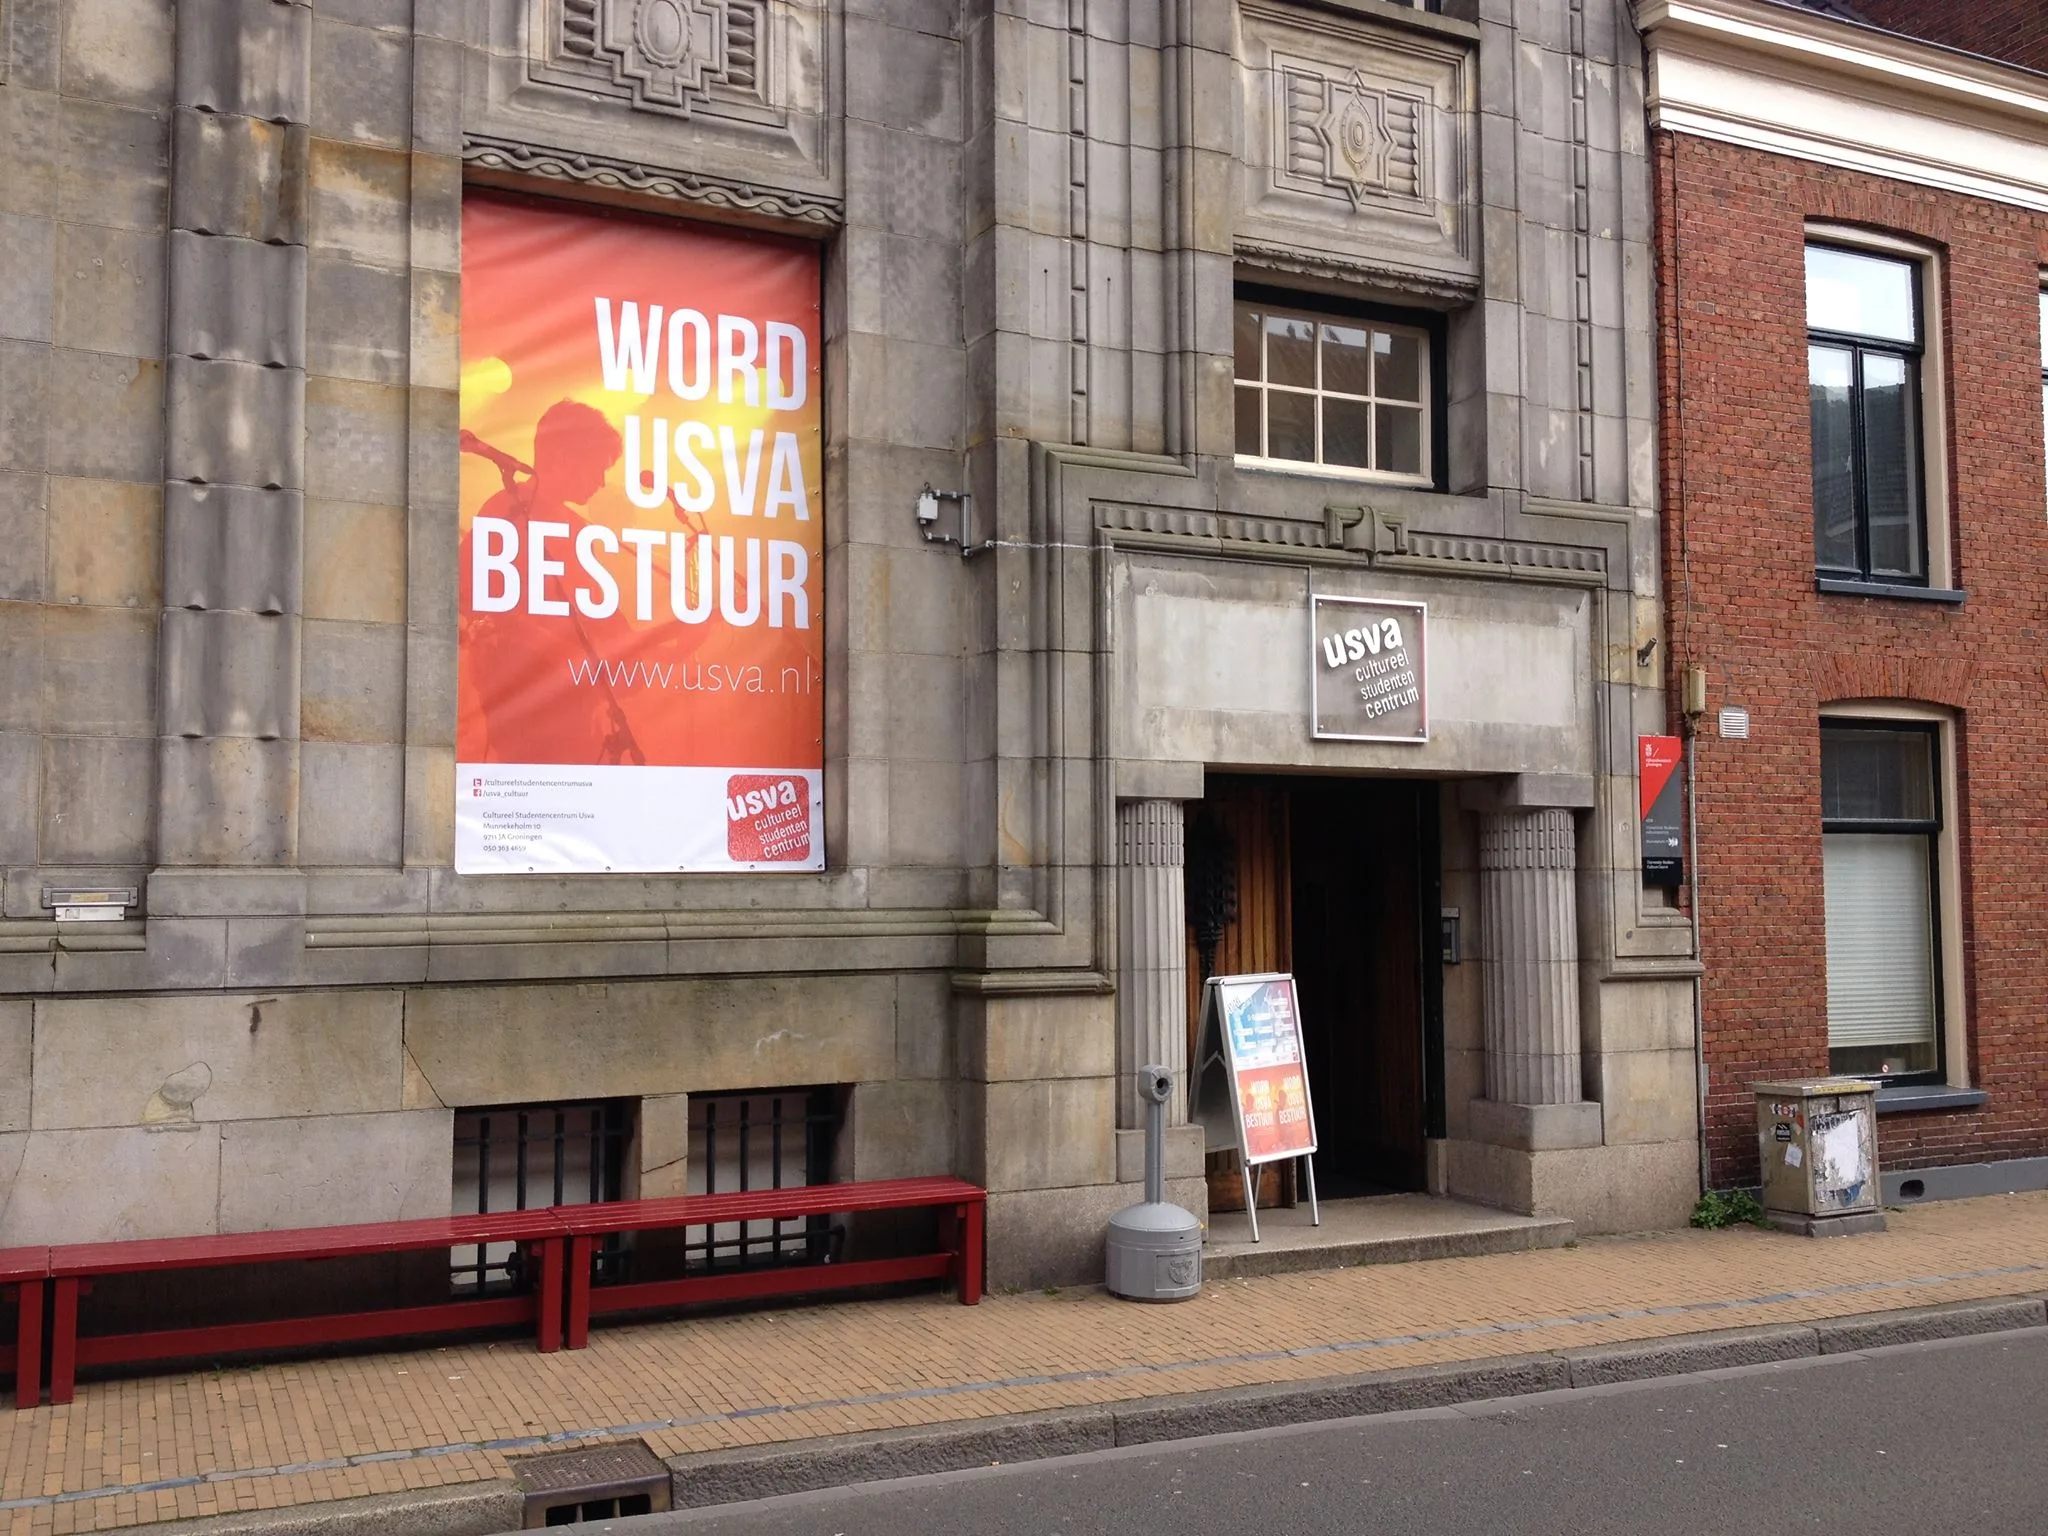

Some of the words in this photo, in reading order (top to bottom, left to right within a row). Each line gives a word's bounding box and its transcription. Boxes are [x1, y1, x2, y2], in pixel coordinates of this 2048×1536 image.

[594, 297, 807, 412] WORD
[624, 415, 810, 521] USVA
[471, 516, 810, 630] BESTUUR
[1322, 617, 1404, 668] usva
[568, 656, 811, 694] www.usva.nl
[1355, 648, 1410, 682] cultureel
[1360, 670, 1415, 700] studenten
[1365, 686, 1420, 719] centrum
[482, 811, 514, 820] Cultureel
[515, 811, 578, 820] Studentencentrum
[726, 780, 798, 821] usva
[754, 803, 803, 832] cultureel
[758, 818, 809, 846] studenten
[763, 831, 812, 859] centrum
